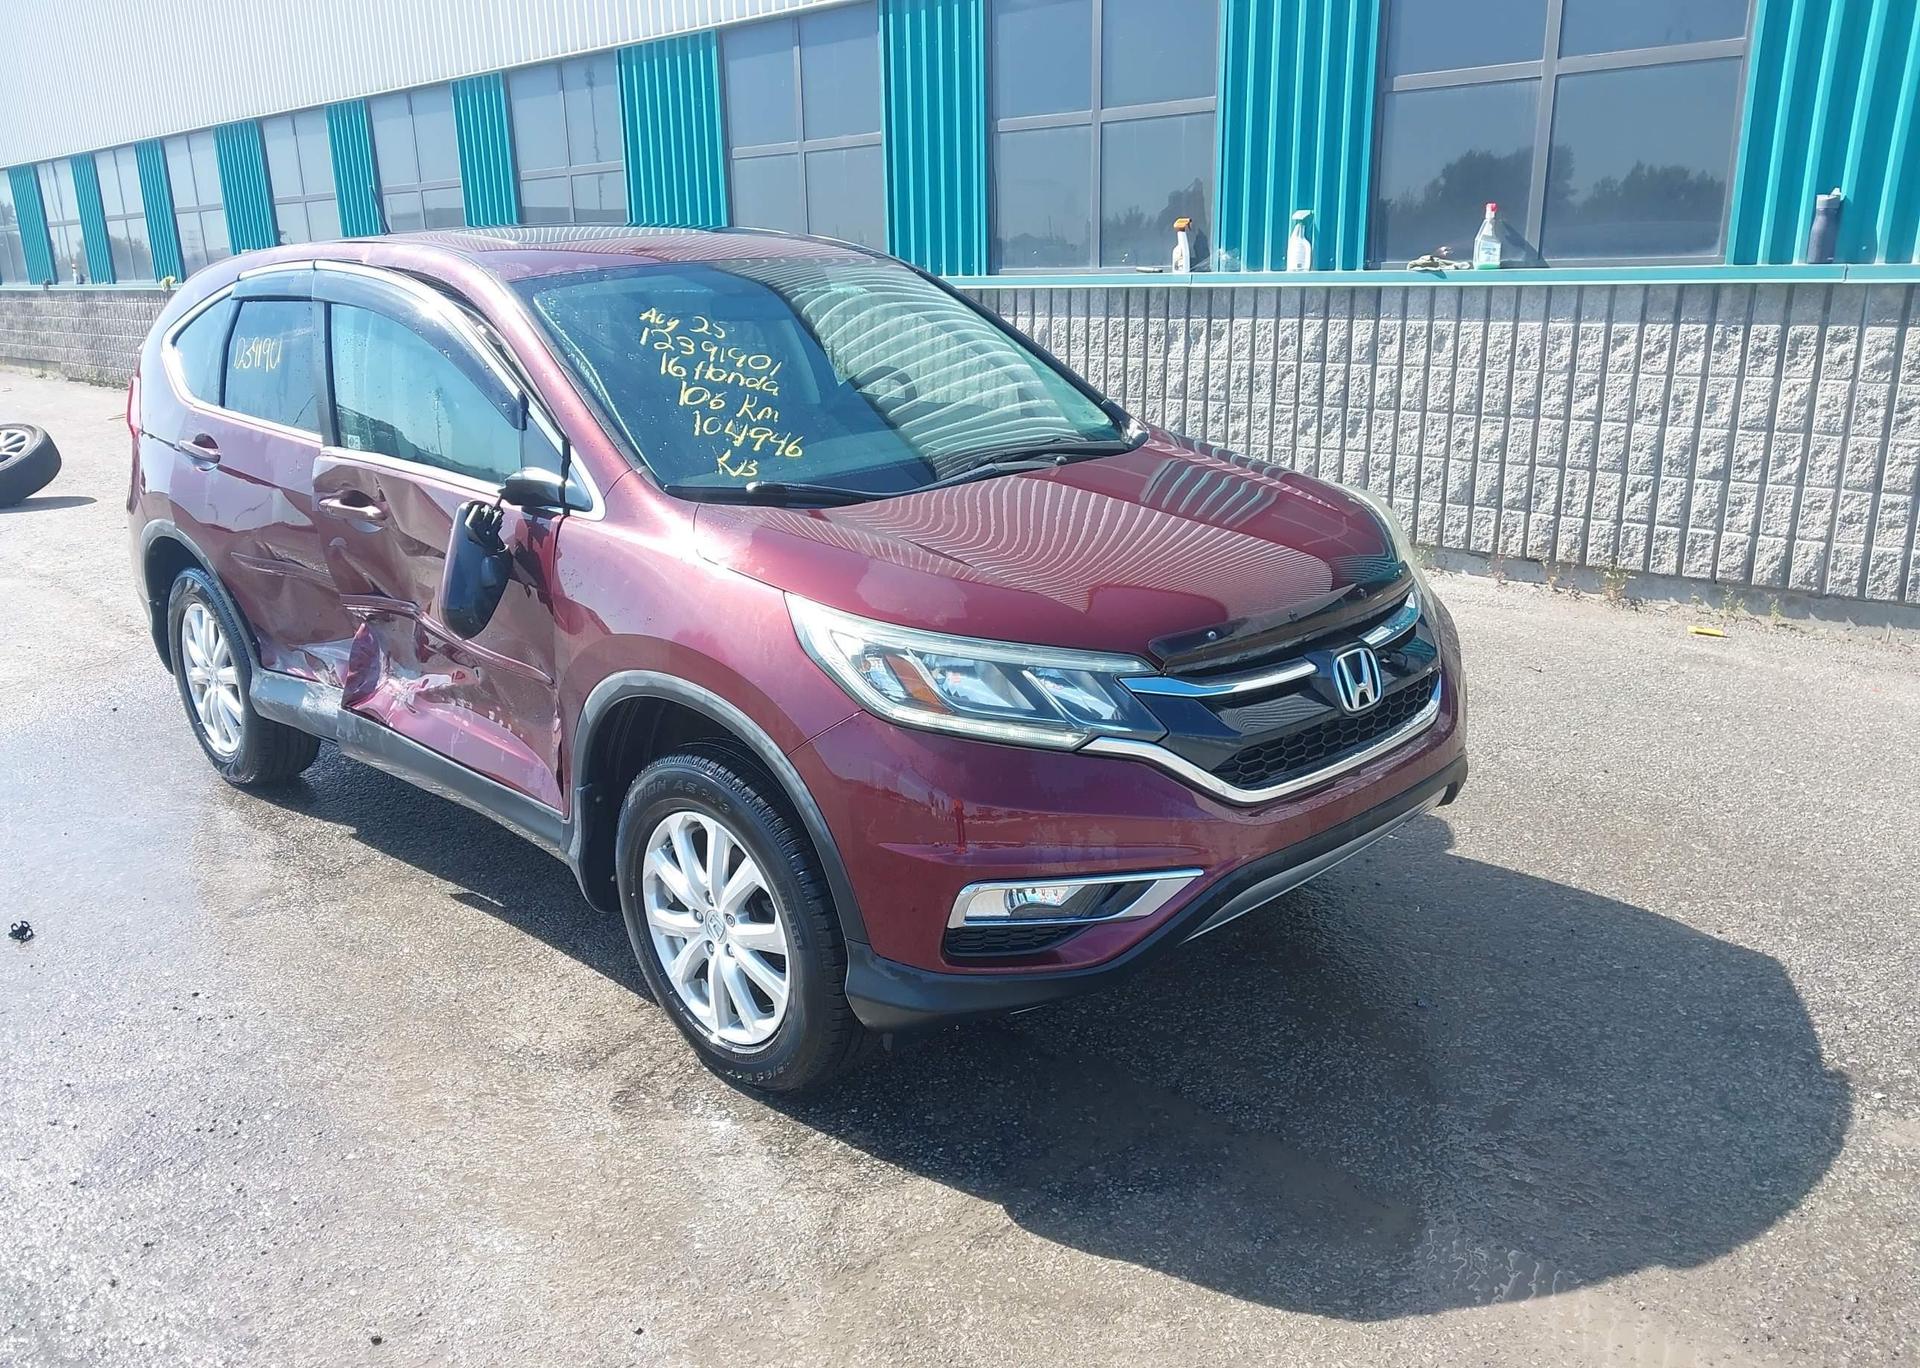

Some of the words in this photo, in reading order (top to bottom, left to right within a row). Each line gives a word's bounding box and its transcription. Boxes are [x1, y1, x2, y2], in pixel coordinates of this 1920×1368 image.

[689, 315, 726, 339] 25
[660, 351, 687, 378] 16
[678, 380, 728, 410] 106
